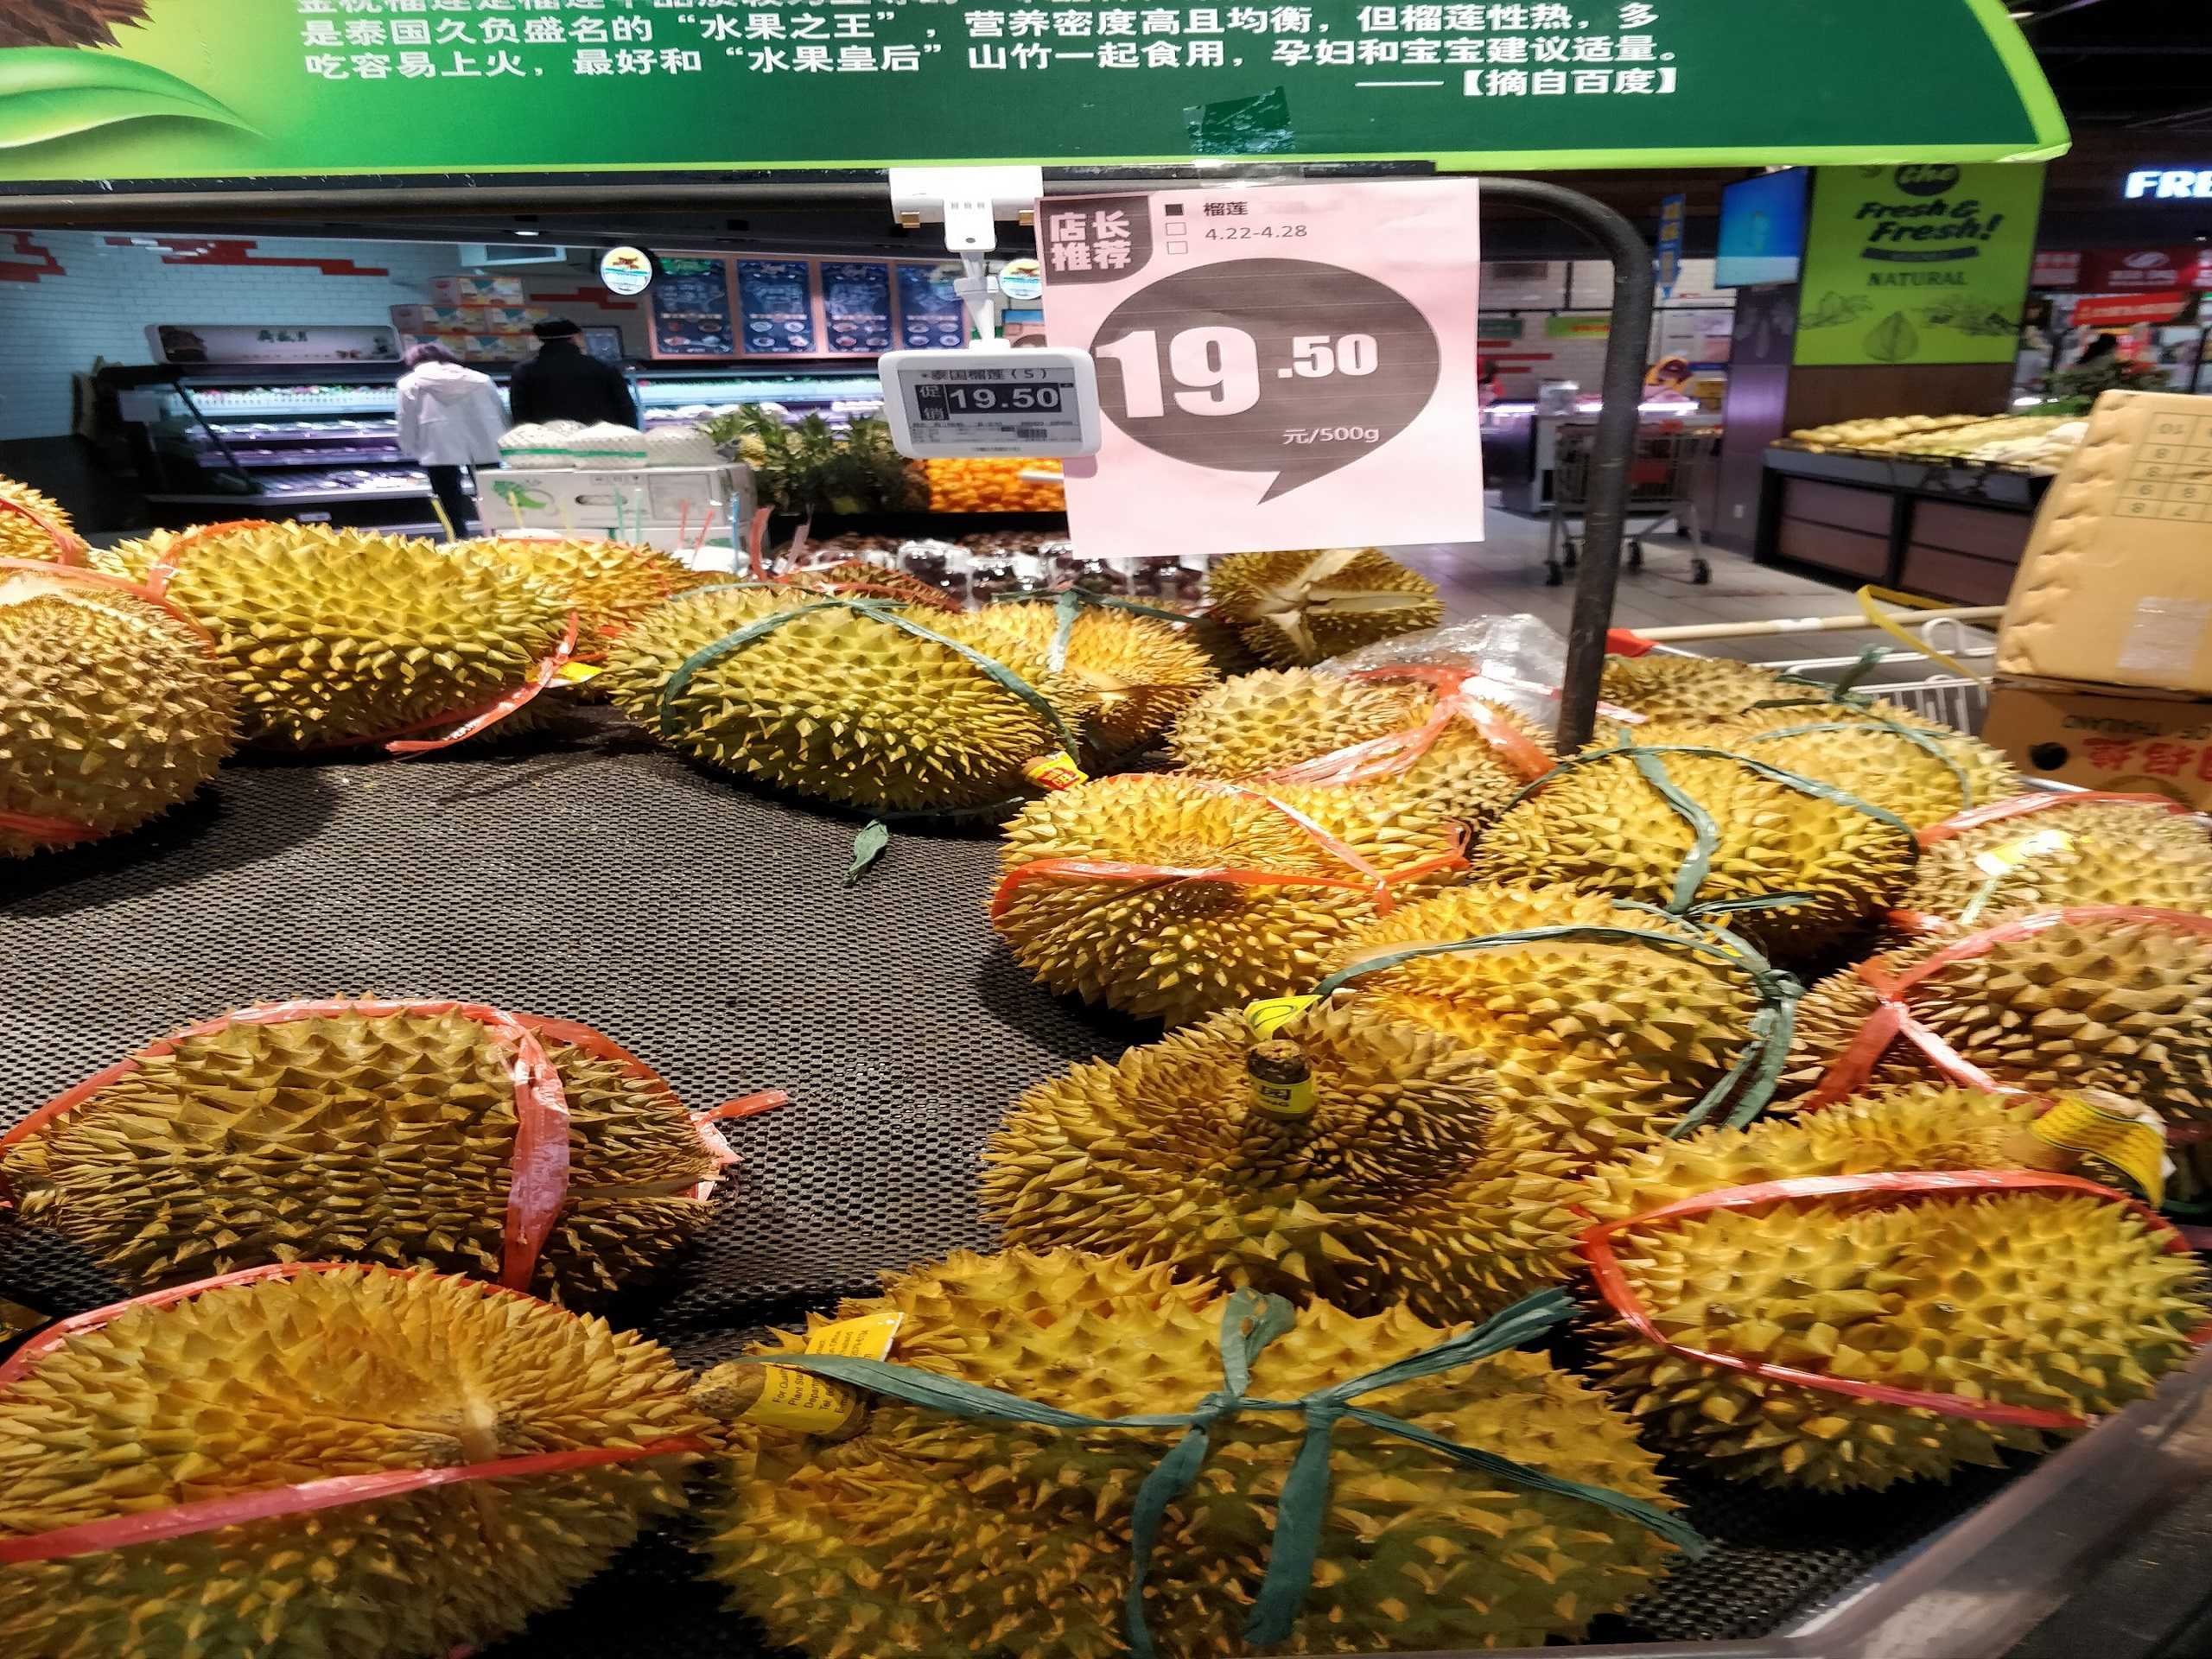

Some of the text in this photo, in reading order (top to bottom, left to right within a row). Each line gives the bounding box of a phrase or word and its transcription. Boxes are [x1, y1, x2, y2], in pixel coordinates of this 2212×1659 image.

[1204, 201, 1249, 216] 榴莲
[1050, 210, 1131, 242] 店长
[1205, 225, 1308, 240] 4.22-4.28
[1051, 240, 1132, 271] 推荐
[1867, 271, 1968, 287] NATURAL
[950, 387, 1059, 410] 19.50
[1281, 427, 1380, 445] 元/500g
